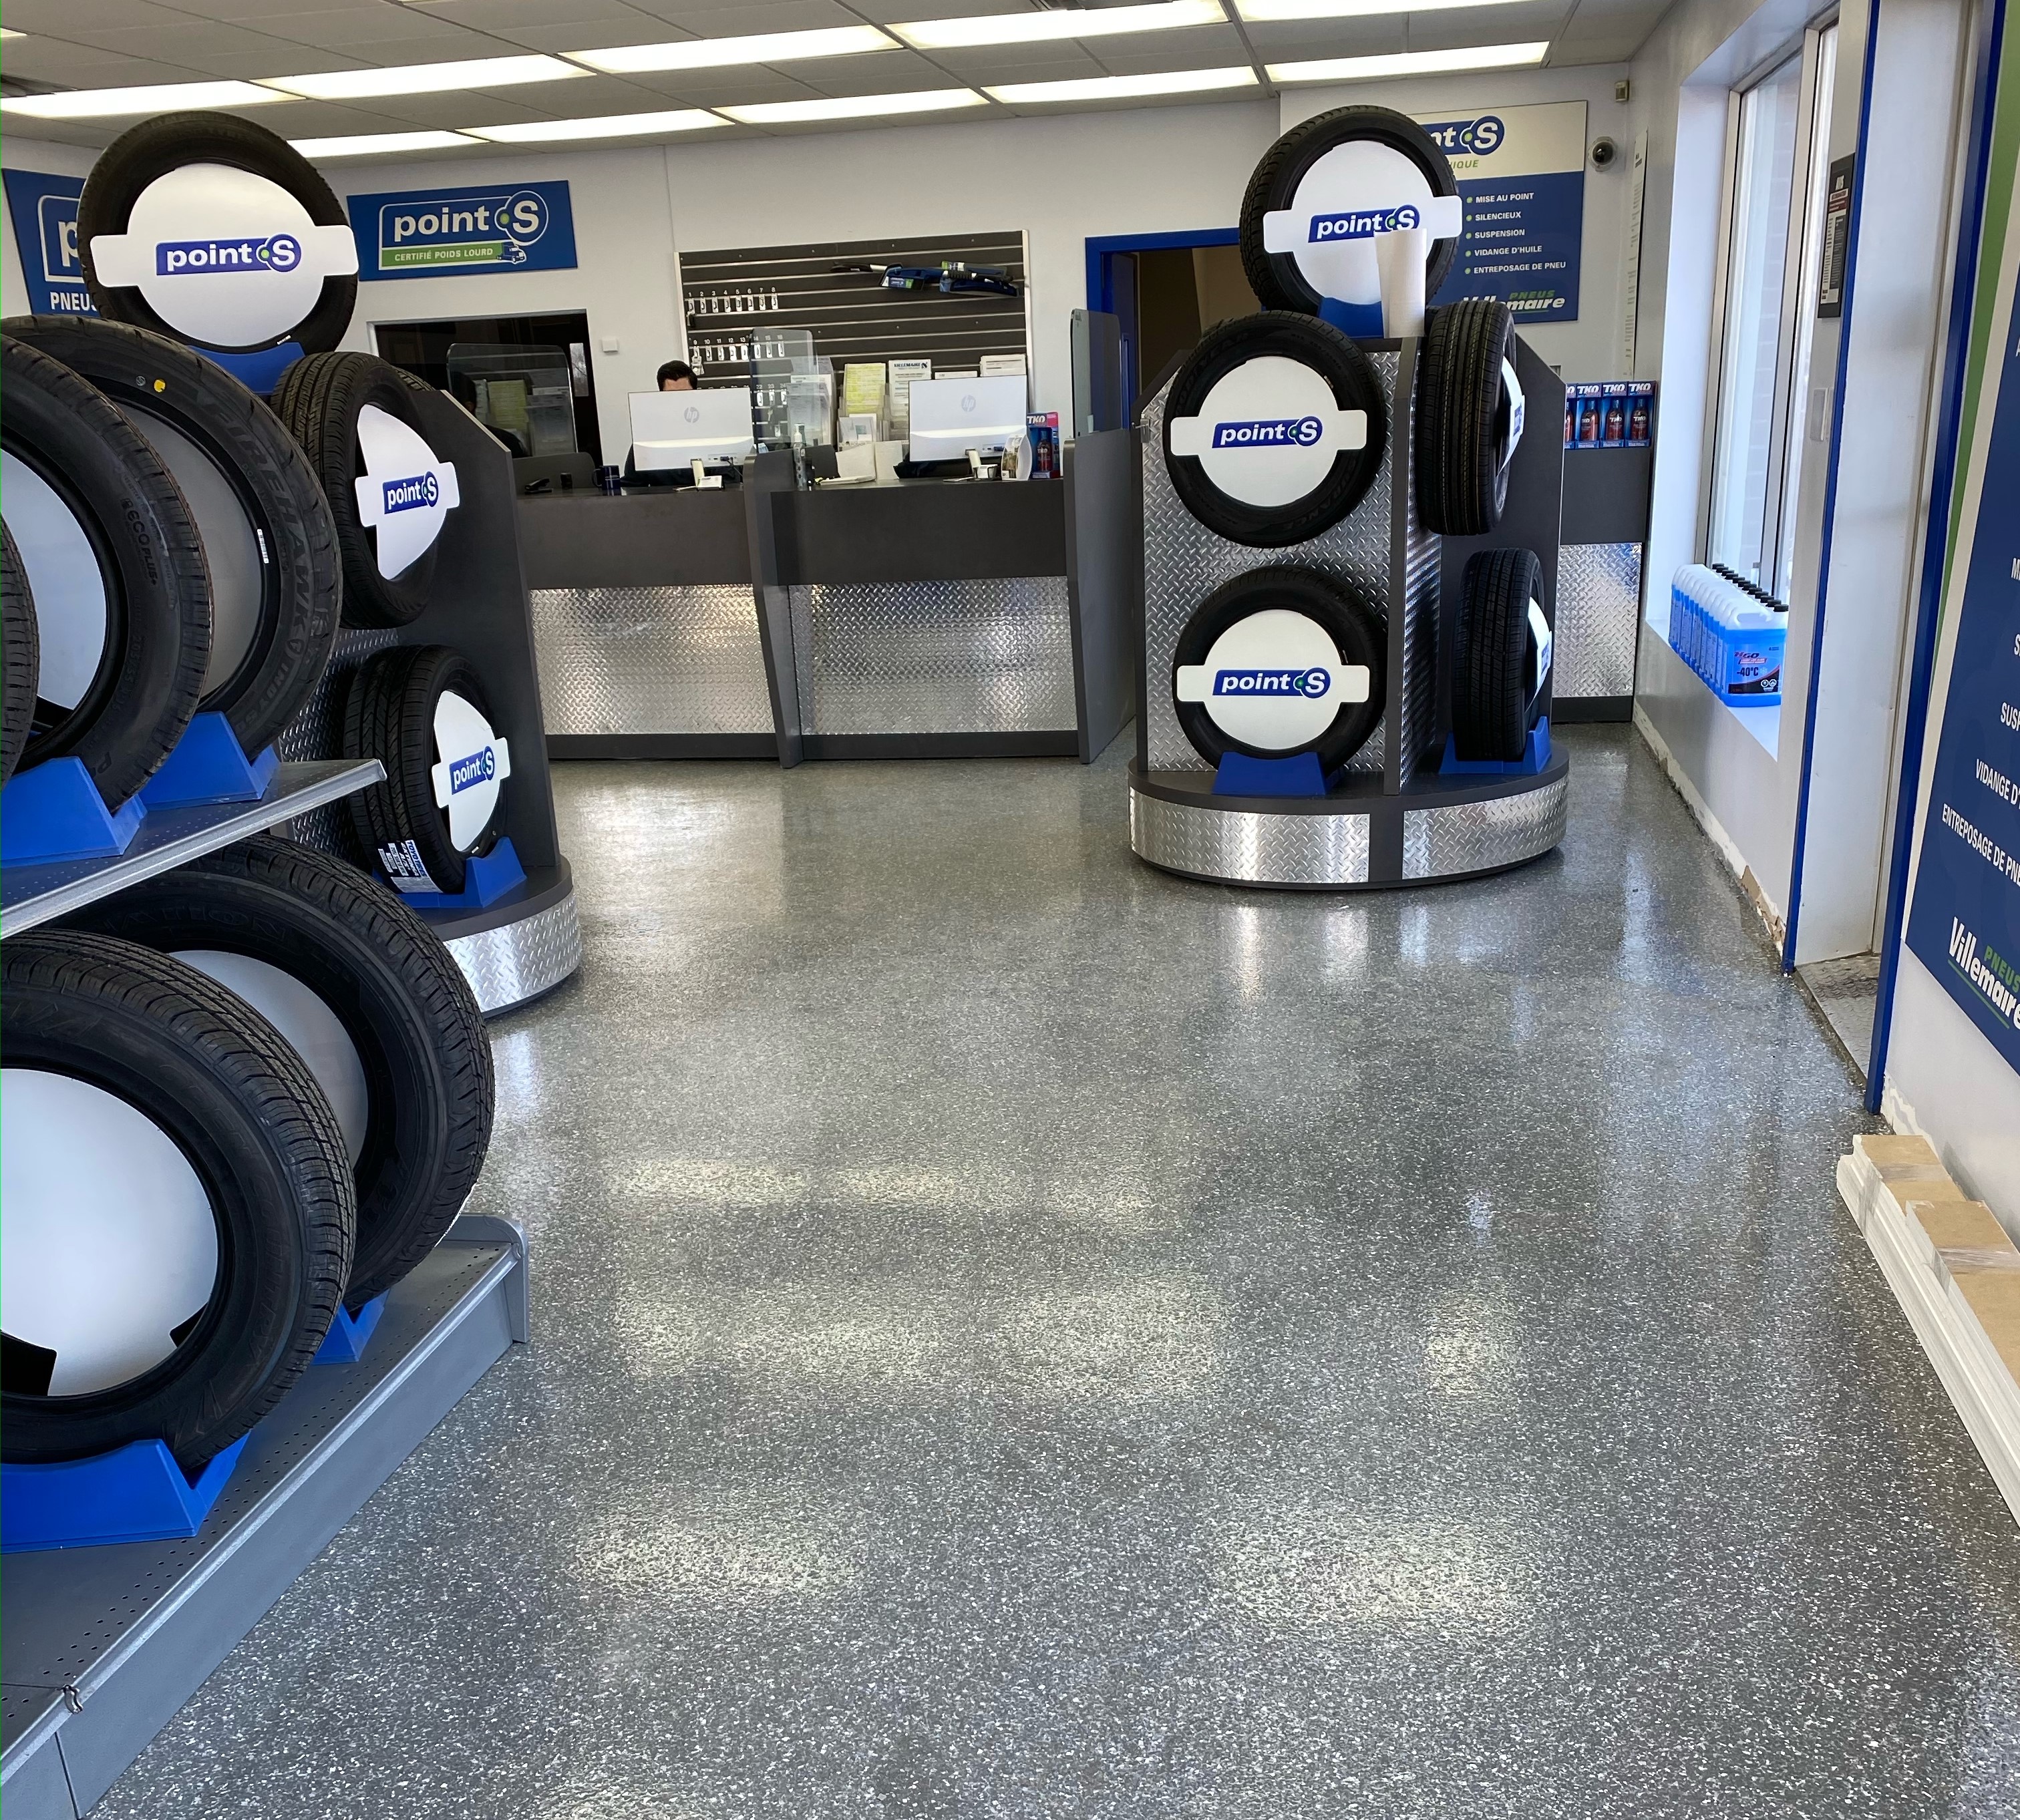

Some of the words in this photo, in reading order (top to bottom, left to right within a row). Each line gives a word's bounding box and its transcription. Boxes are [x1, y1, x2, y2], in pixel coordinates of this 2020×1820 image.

[1474, 122, 1498, 149] S
[1476, 196, 1495, 204] MISE
[1496, 194, 1508, 202] AU
[1510, 192, 1534, 200] POINT
[394, 205, 490, 242] point
[512, 200, 539, 233] S
[1317, 213, 1383, 239] point
[1396, 209, 1415, 230] S
[1475, 211, 1522, 221] SILENCIEUX
[1474, 229, 1525, 239] SUSPENSION
[167, 243, 252, 271] point
[272, 240, 295, 266] S
[395, 250, 432, 261] CERTIFIÉ
[435, 250, 461, 259] POIDS
[464, 248, 493, 257] LOURD
[1474, 247, 1510, 256] VIDANGE
[1511, 245, 1542, 254] D'HUILE
[1474, 264, 1530, 274] ENTREPOSAGE
[1509, 290, 1556, 300] PNEUS
[1577, 385, 1599, 394] TKO
[1603, 384, 1625, 393] TKO
[1629, 383, 1651, 392] TKO
[961, 395, 976, 411] hp
[684, 407, 699, 423] hp
[1027, 415, 1045, 424] TKO
[1220, 423, 1285, 445] point
[1299, 421, 1318, 441] S
[387, 481, 421, 510] point
[428, 477, 437, 501] S
[2014, 634, 2020, 657] S
[1221, 673, 1291, 693] point
[1305, 672, 1325, 693] S
[454, 757, 481, 789] point
[486, 751, 493, 775] S
[1975, 759, 2011, 801] VIDANGE
[2011, 783, 2020, 809] D'
[1942, 803, 1993, 862] ENTREPOSAGE
[1993, 846, 2006, 872] DE
[1949, 916, 2020, 1029] Villemaire
[1984, 945, 2020, 993] PNEUS
